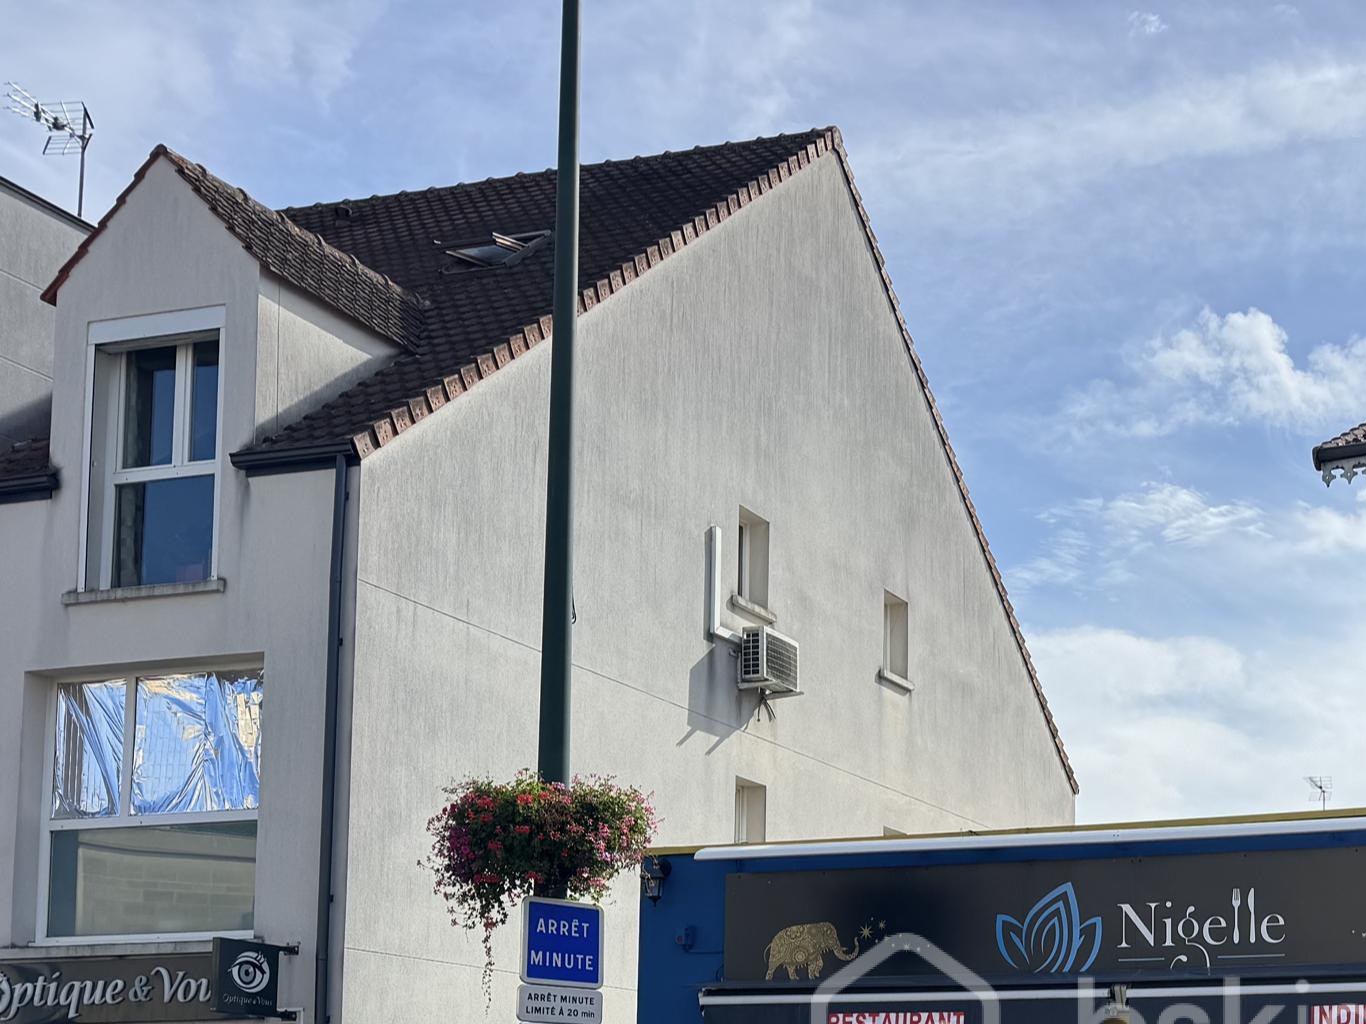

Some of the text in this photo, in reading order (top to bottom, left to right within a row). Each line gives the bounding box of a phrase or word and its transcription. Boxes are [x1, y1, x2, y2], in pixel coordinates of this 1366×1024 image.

[536, 918, 590, 938] ARRÊT
[1116, 887, 1286, 971] Nigelle
[530, 950, 594, 971] MINUTE
[128, 975, 152, 1002] &
[527, 992, 595, 1005] ARRÊT MINUTE
[525, 1005, 595, 1018] LIMITÉ À 20 min
